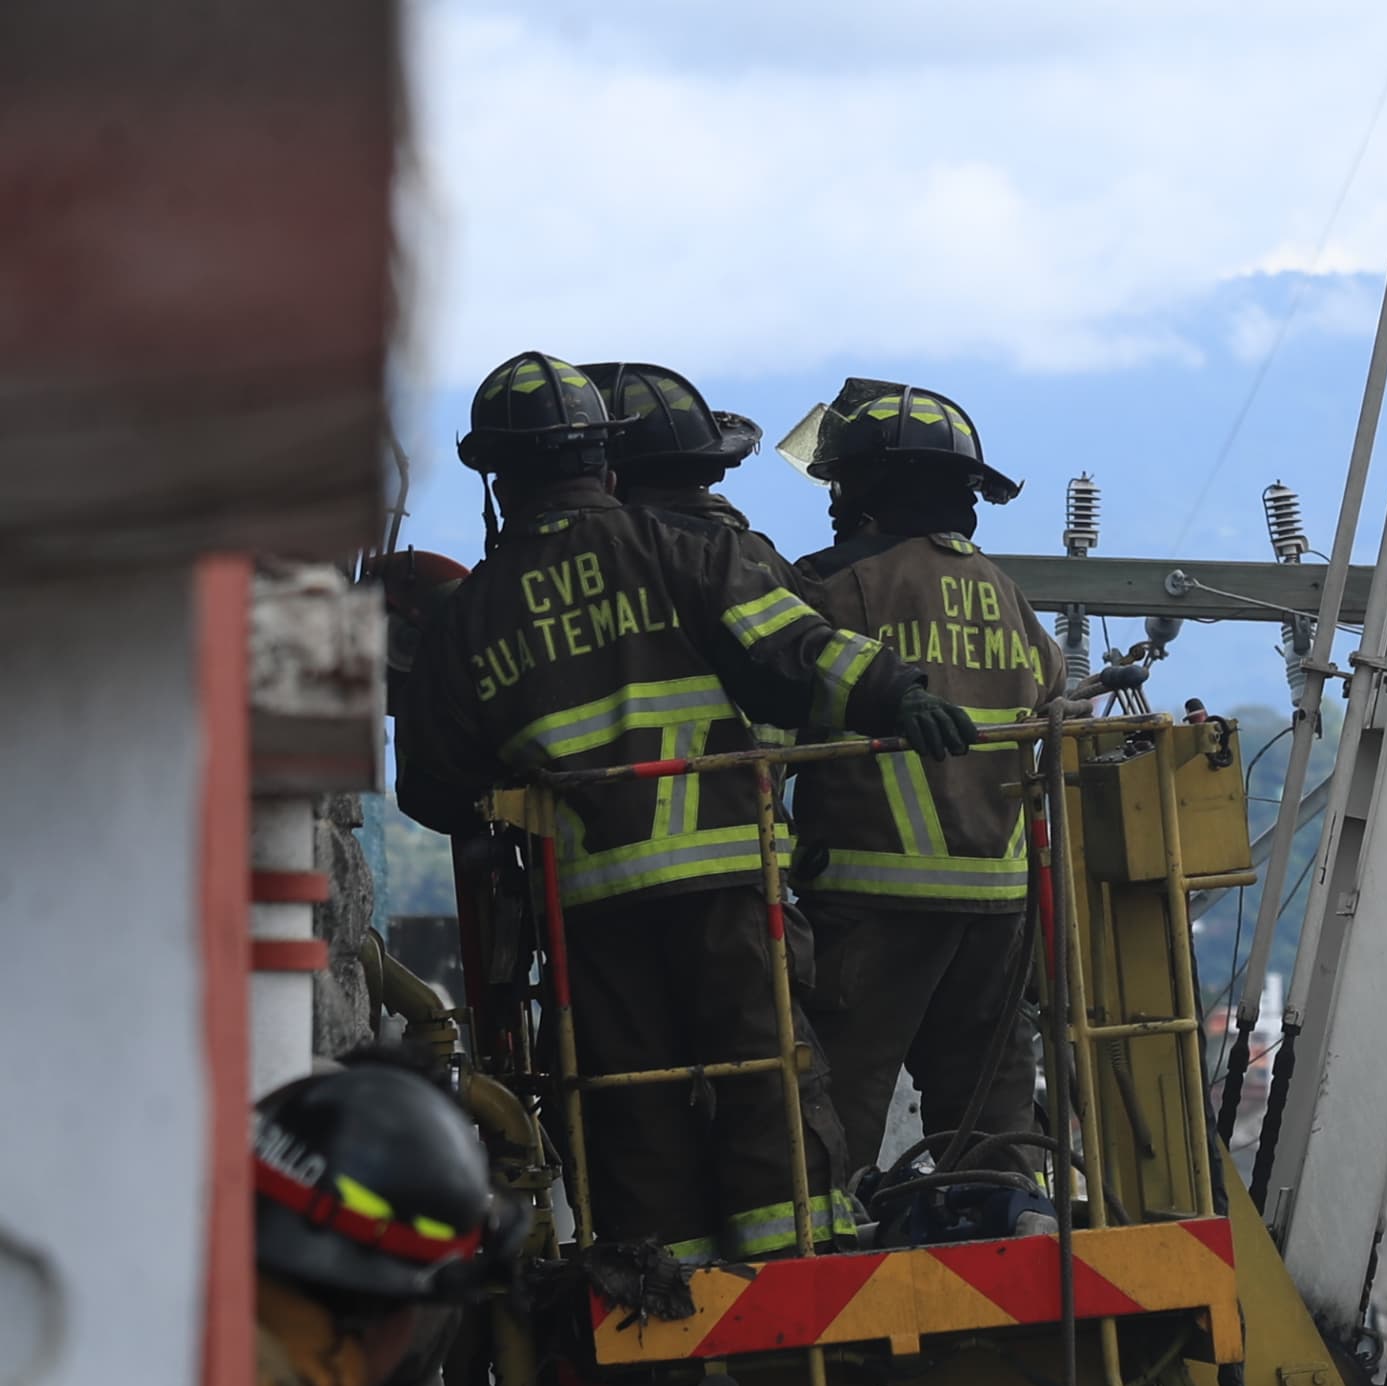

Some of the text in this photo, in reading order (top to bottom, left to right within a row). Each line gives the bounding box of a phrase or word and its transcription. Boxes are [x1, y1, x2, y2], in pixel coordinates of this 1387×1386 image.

[521, 552, 604, 613] CVB
[941, 576, 999, 621] CVB
[471, 587, 680, 701] GUATEMAL
[879, 620, 1044, 686] UATEMAA
